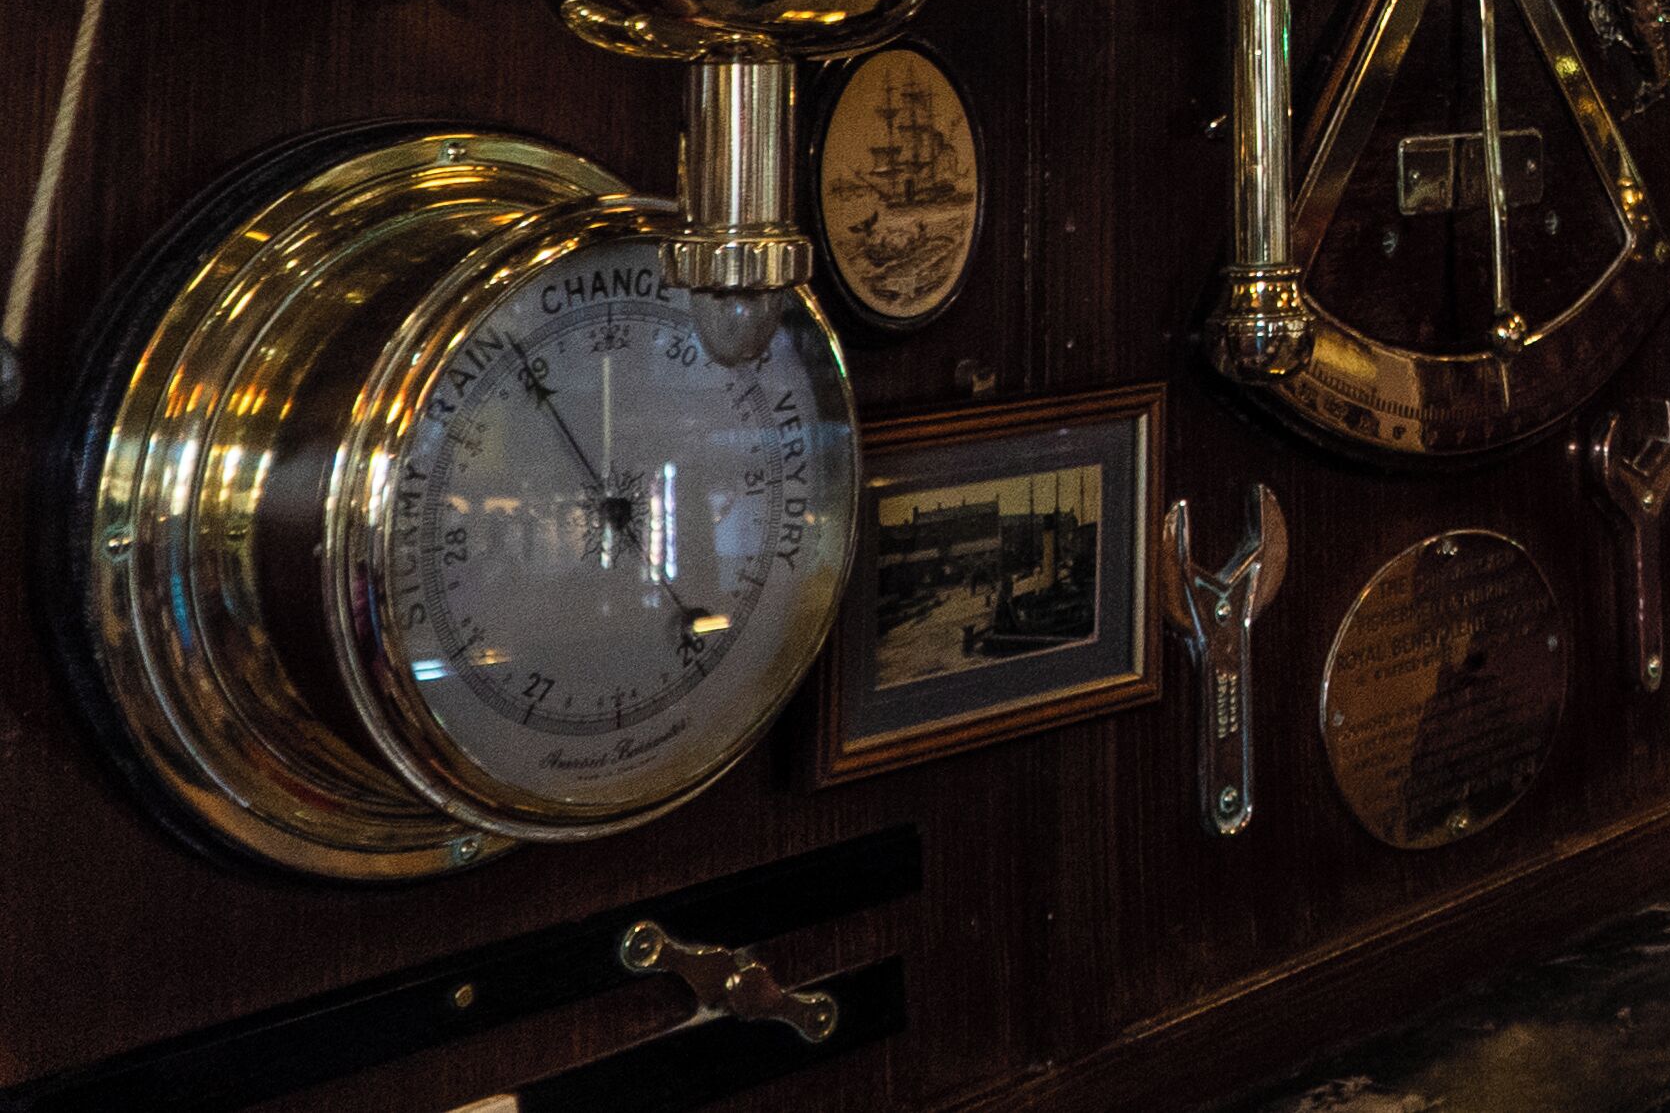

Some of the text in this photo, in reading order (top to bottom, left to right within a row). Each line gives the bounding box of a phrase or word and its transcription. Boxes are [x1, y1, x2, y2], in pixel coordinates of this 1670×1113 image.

[540, 266, 672, 316] CHANGE
[665, 334, 699, 368] 30
[427, 327, 505, 427] RAIN
[518, 356, 550, 394] 29
[743, 468, 766, 497] 31
[773, 389, 808, 573] VERY DRY
[444, 527, 469, 567] 28
[521, 672, 555, 705] 27
